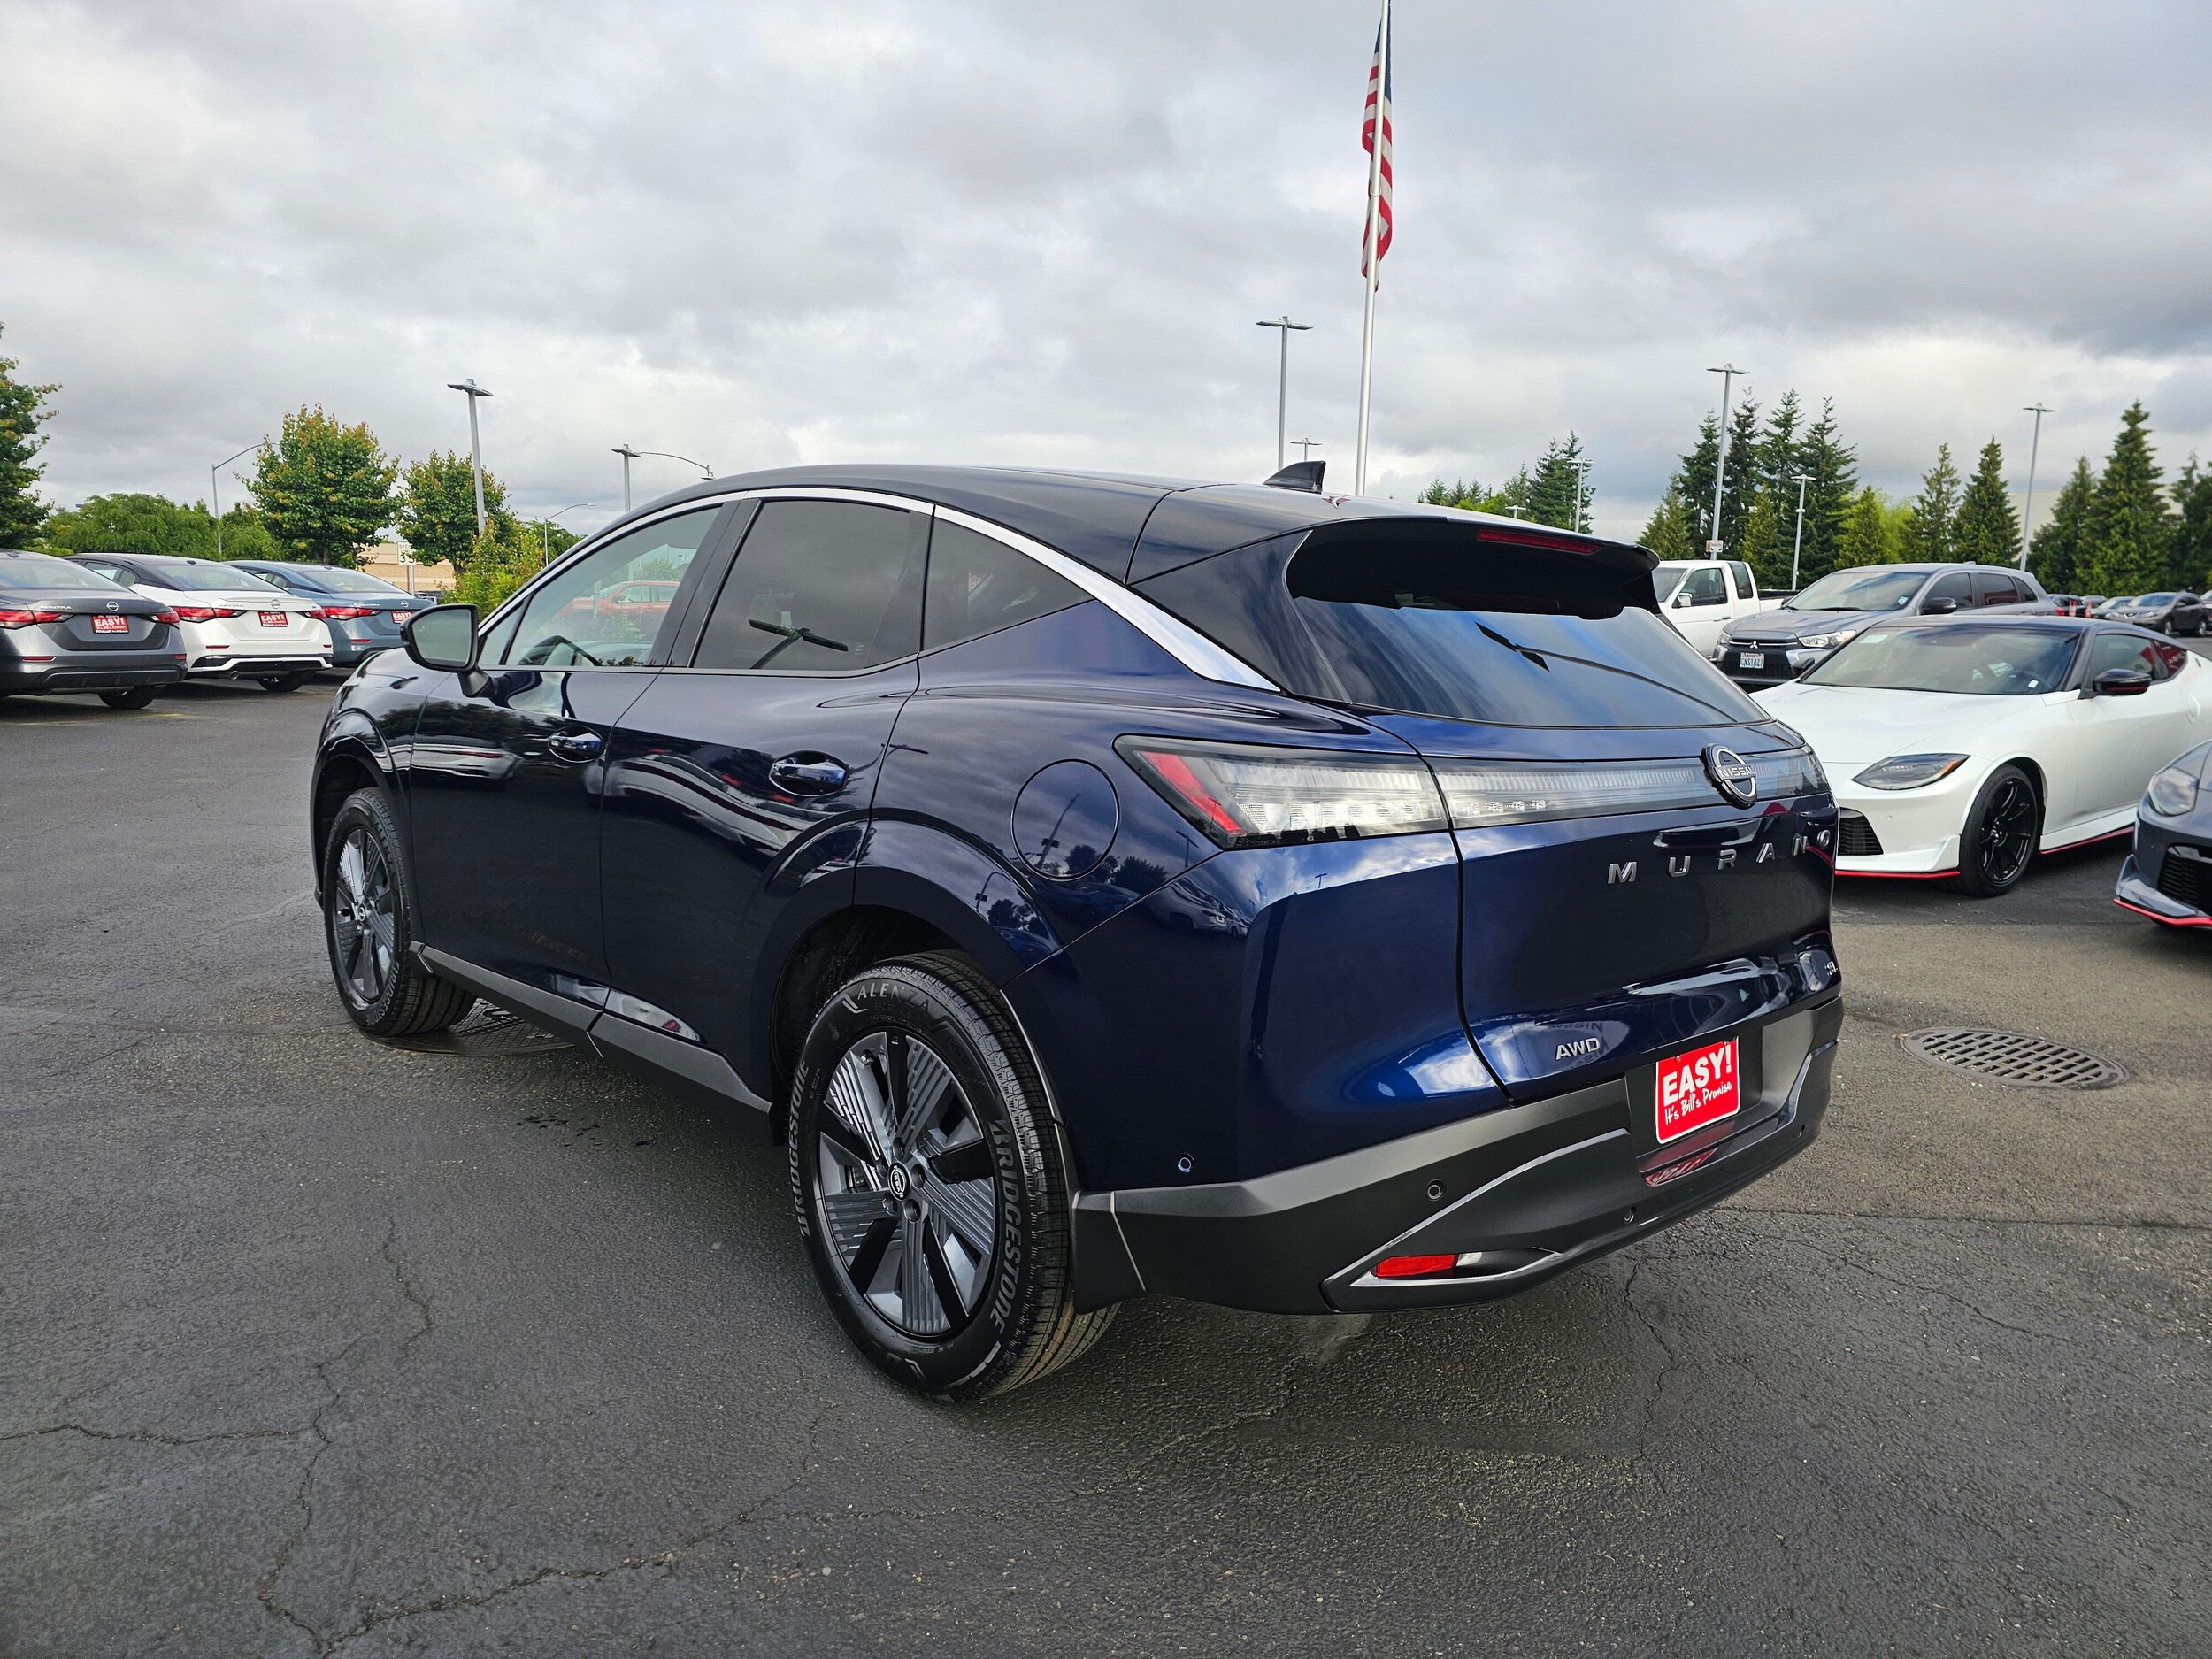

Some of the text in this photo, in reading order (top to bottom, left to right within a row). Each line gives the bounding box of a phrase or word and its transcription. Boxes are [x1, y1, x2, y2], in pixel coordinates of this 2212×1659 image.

[94, 618, 125, 626] EASY!
[1717, 766, 1755, 777] NISSAN
[1607, 829, 1832, 884] MURANO
[856, 982, 930, 1015] ALENZA
[1555, 1036, 1601, 1061] AWD
[1663, 1043, 1732, 1107] EASY!
[1664, 1080, 1733, 1125] It's Bill's Promise
[787, 1059, 810, 1237] BRIDGESTONE
[987, 1118, 1024, 1335] BRIDGESTONE
